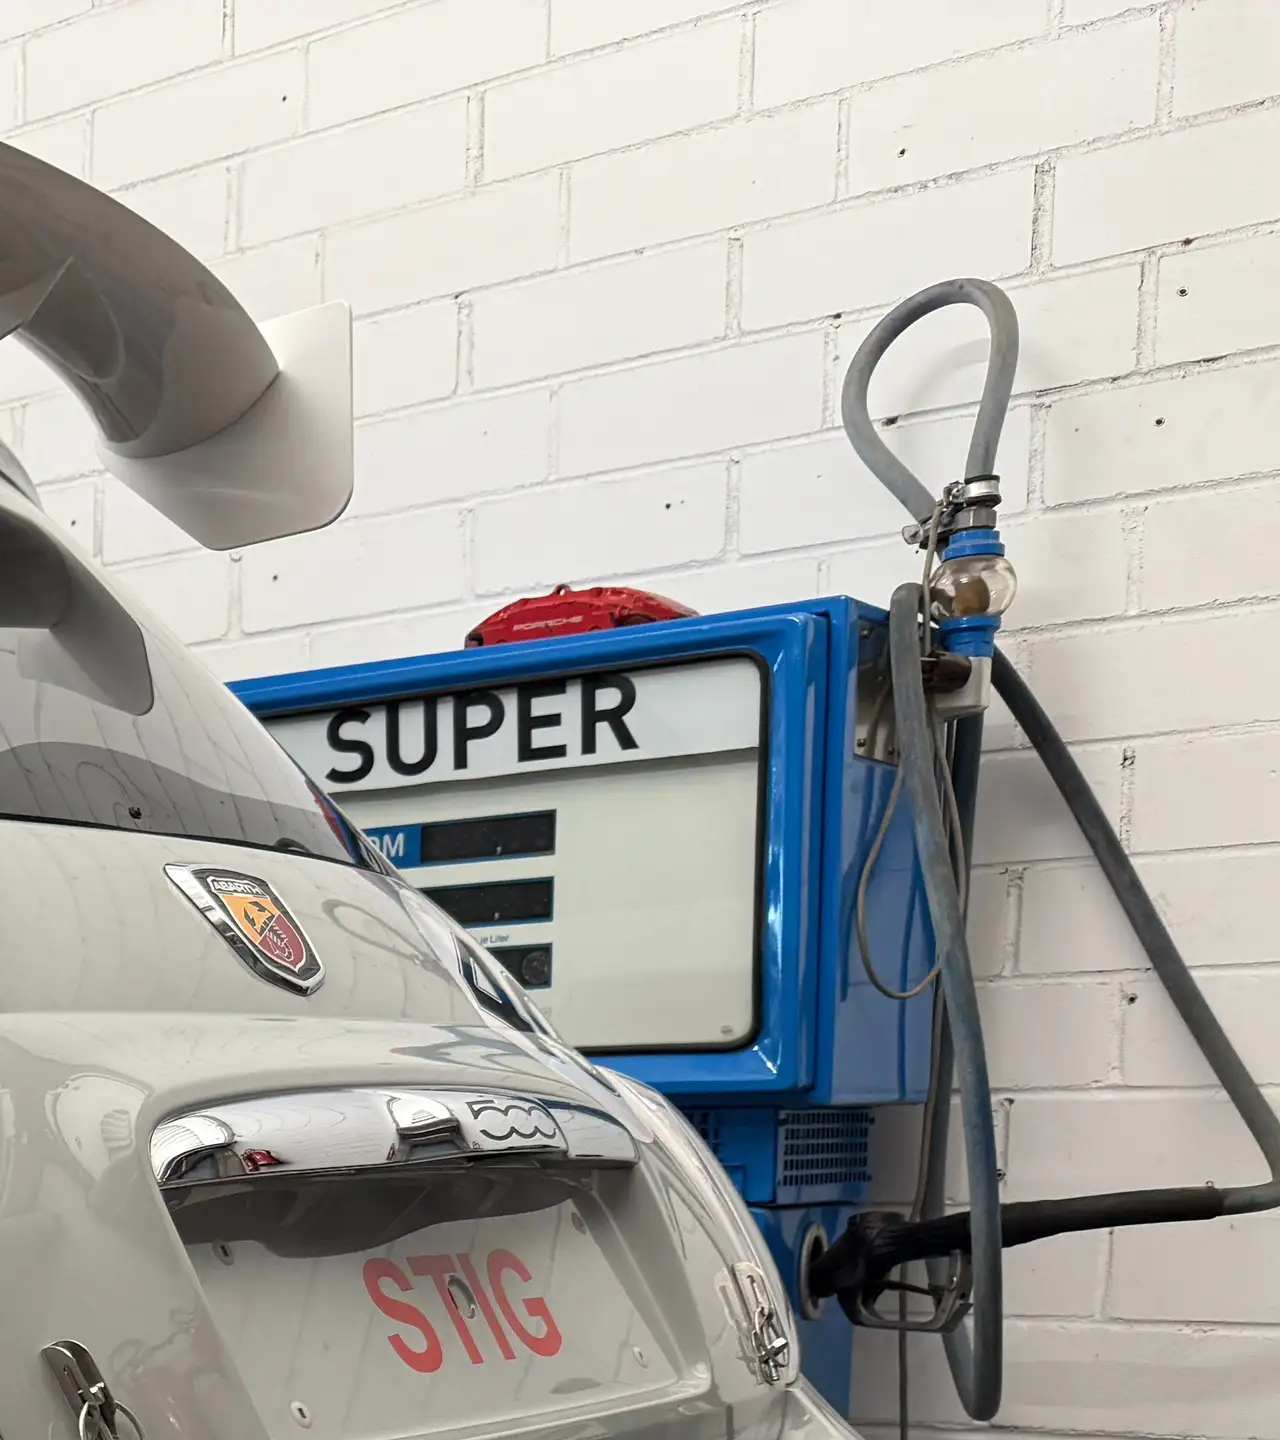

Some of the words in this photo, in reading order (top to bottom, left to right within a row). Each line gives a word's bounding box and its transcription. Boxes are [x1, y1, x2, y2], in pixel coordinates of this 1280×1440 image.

[512, 614, 585, 632] PORSCHE
[324, 672, 640, 784] SUPER
[213, 880, 265, 897] ABARTH
[465, 1099, 557, 1142] 500
[362, 1248, 563, 1374] STIG
